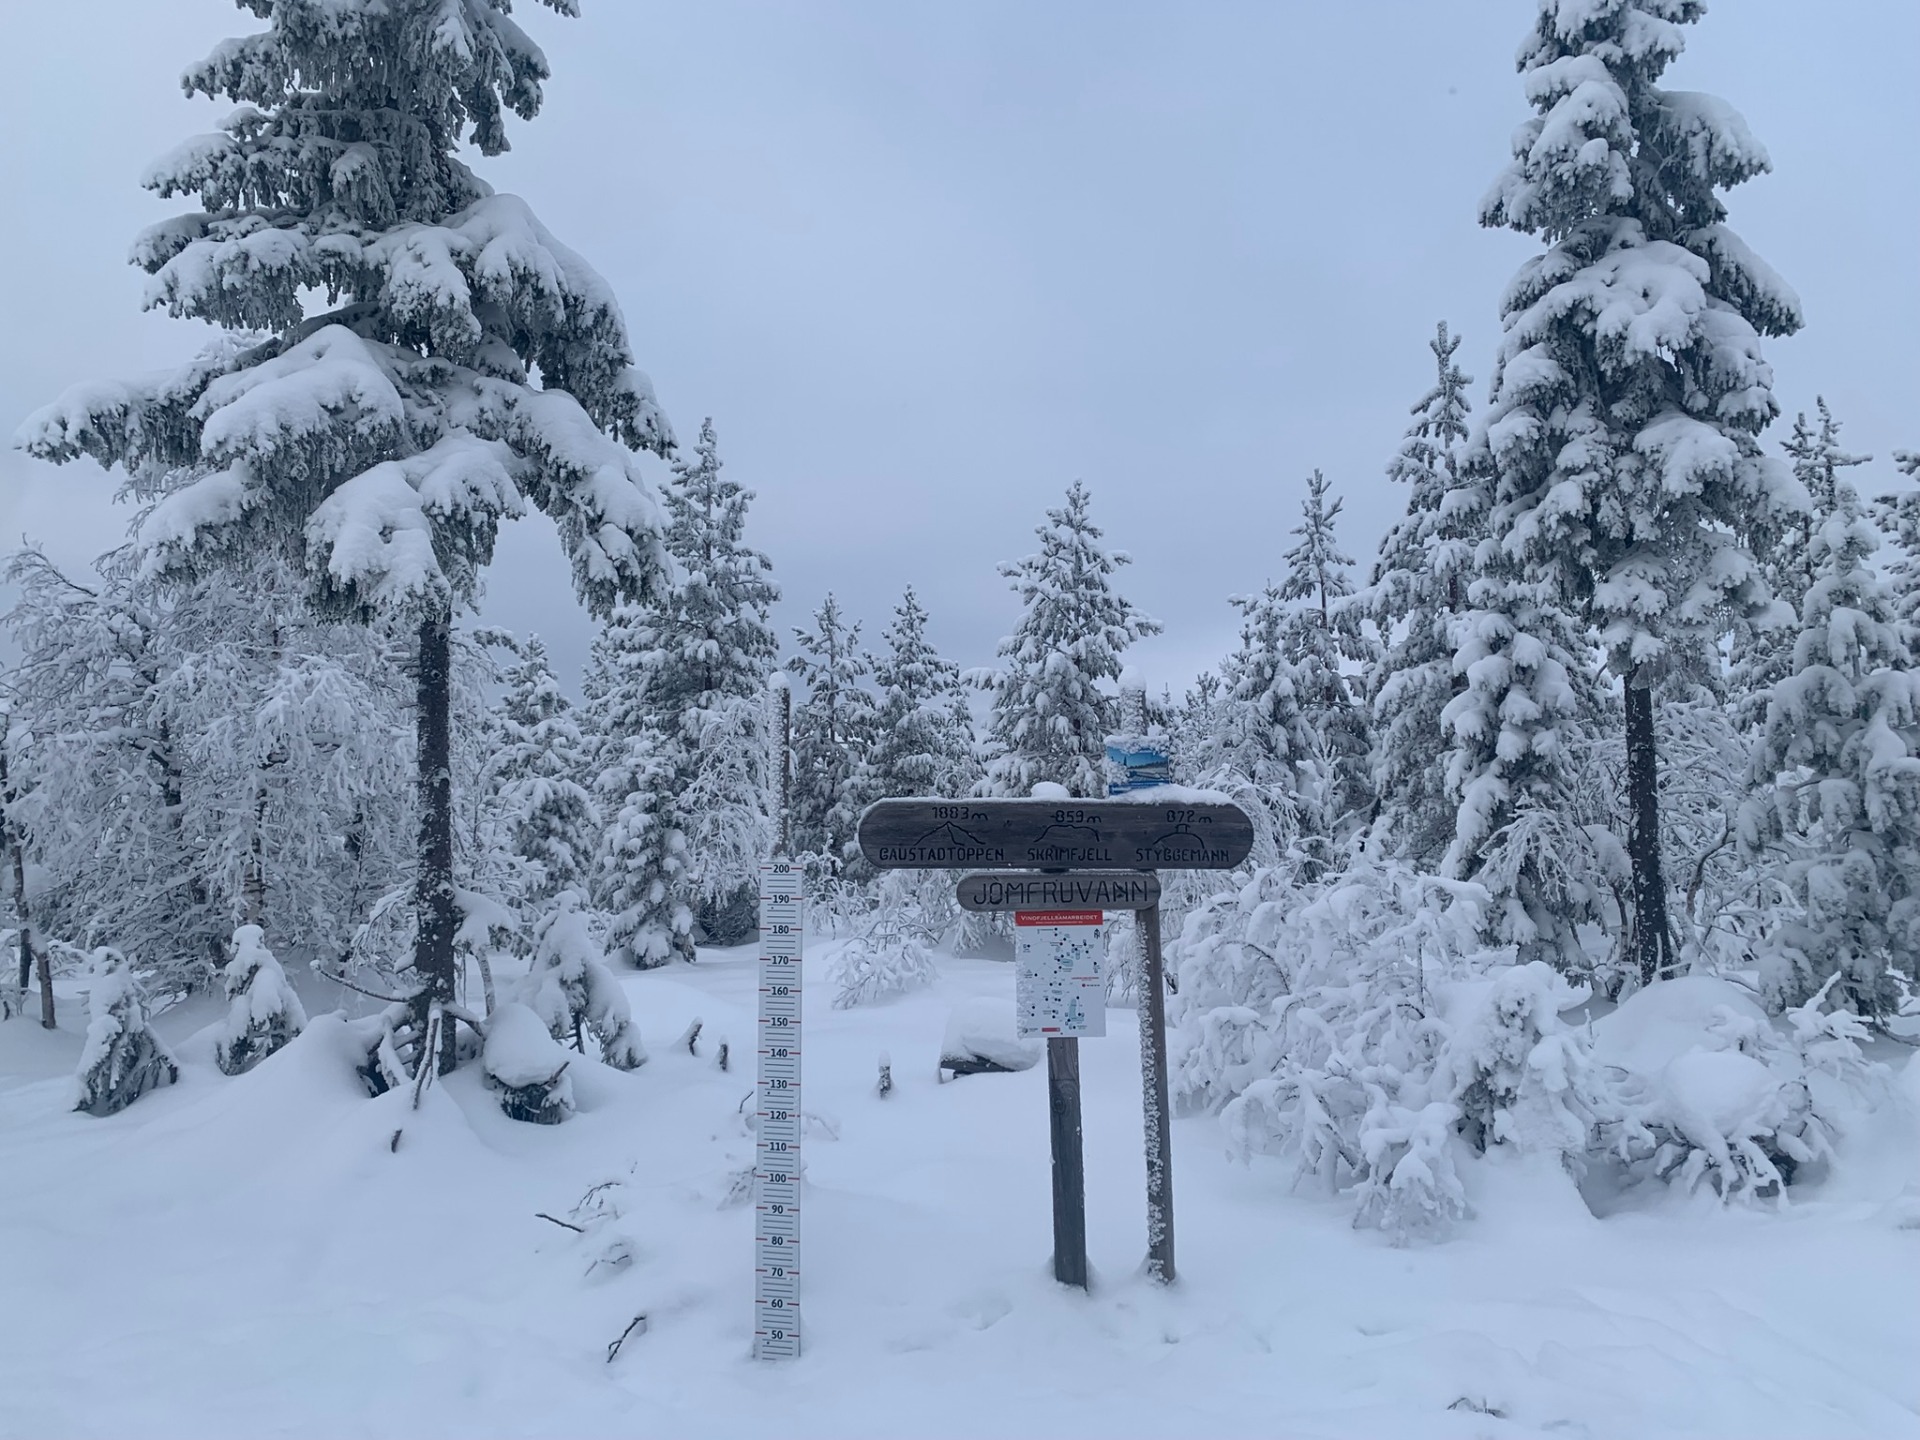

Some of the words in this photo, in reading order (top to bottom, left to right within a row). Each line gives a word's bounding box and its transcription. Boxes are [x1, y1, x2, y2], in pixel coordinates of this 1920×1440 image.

[879, 847, 1005, 861] GAUSTADTOPPEN
[1027, 847, 1113, 861] SKRIMFJELL
[1136, 848, 1230, 862] STYGGEMANN
[773, 864, 790, 873] 200
[772, 895, 790, 903] 190
[772, 925, 789, 934] 180
[772, 956, 789, 964] 170
[771, 986, 789, 995] 160
[771, 1018, 788, 1026] 150
[770, 1049, 788, 1057] 140
[770, 1080, 787, 1088] 130
[769, 1111, 787, 1120] 120
[769, 1142, 787, 1151] 110
[769, 1174, 786, 1182] 100
[771, 1205, 784, 1213] 90
[771, 1236, 783, 1245] 80
[771, 1268, 783, 1276] 70
[771, 1299, 783, 1308] 60
[771, 1331, 783, 1339] 50
